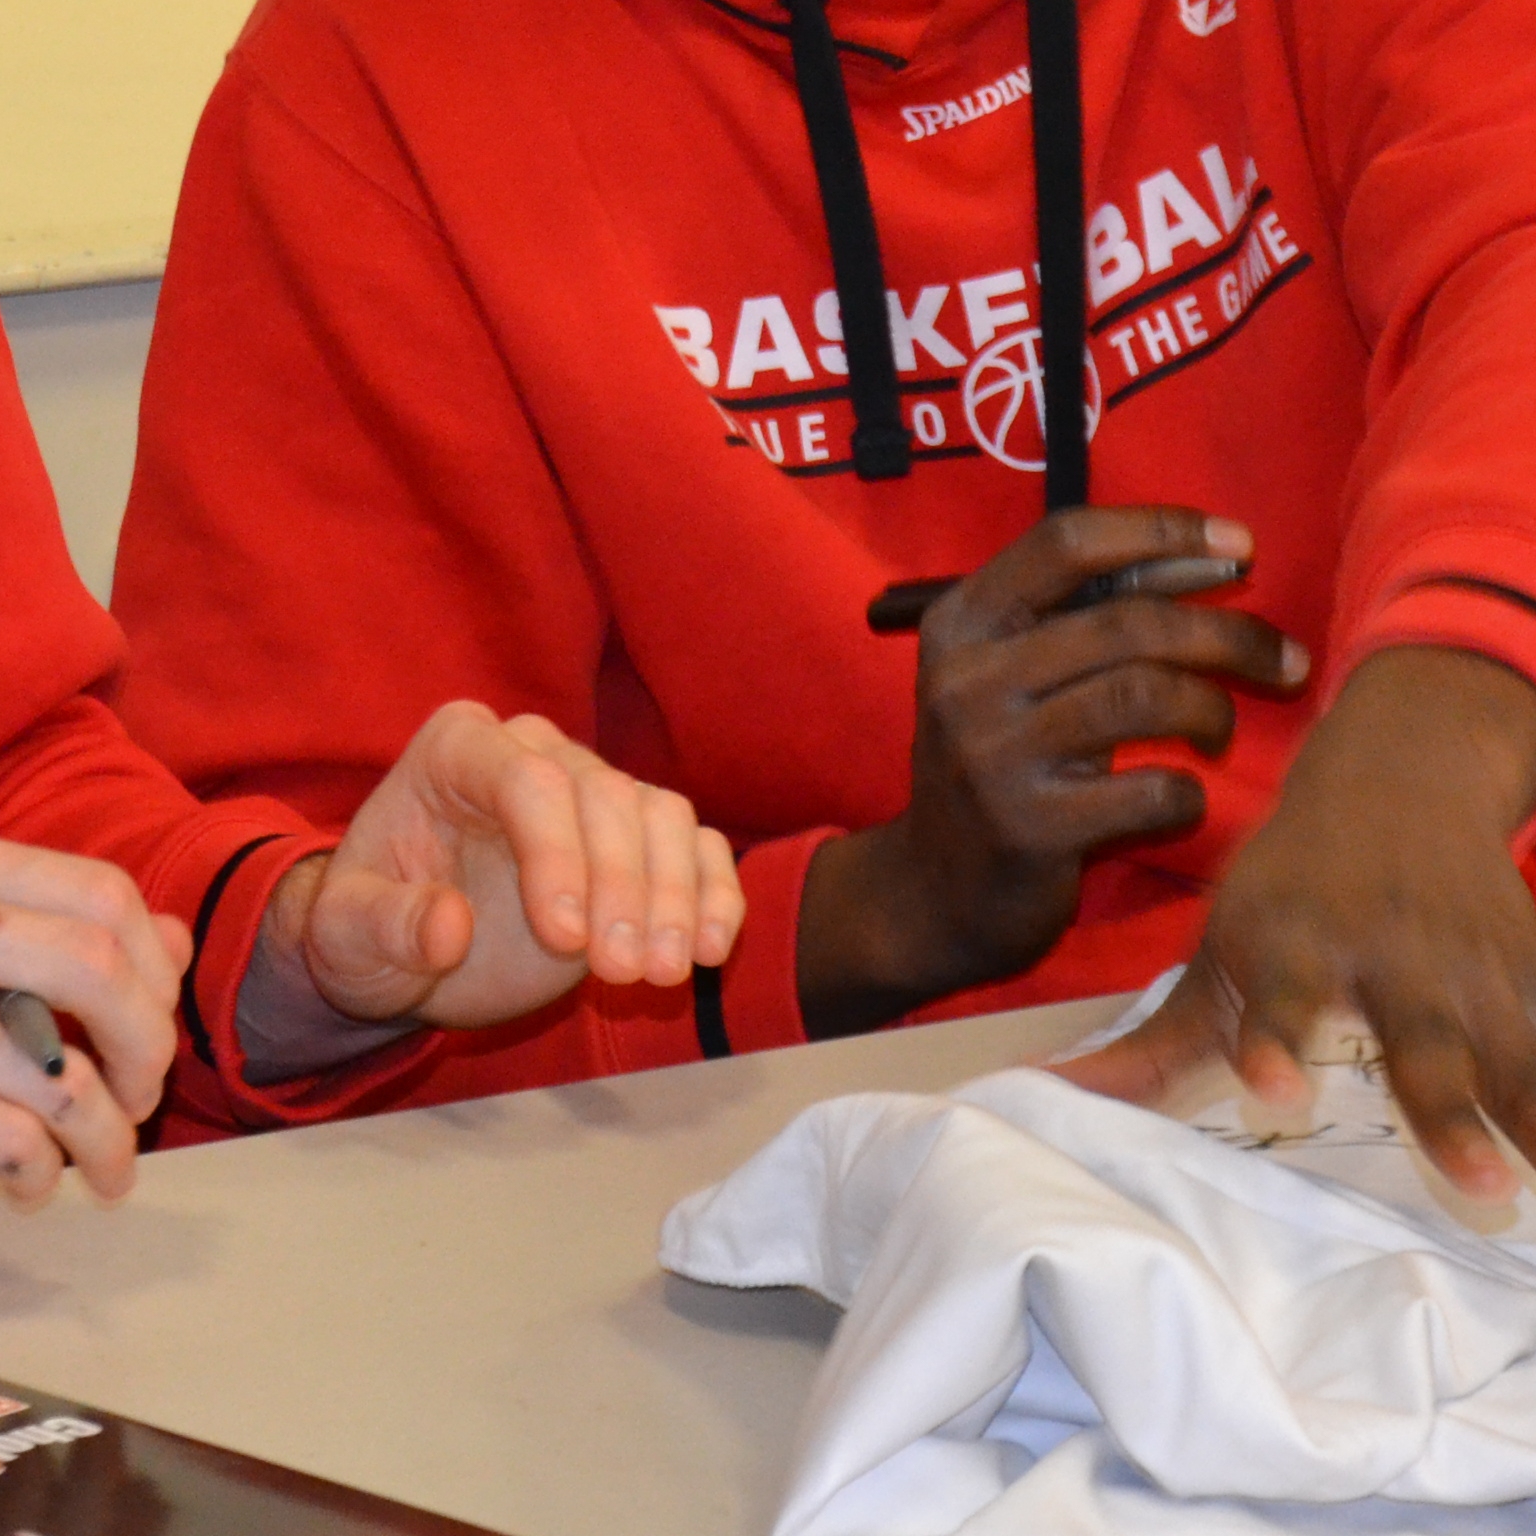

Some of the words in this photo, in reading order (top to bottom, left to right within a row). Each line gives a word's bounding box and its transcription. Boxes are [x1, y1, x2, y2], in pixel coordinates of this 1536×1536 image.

[901, 64, 1032, 142] SPALDIN
[653, 144, 1260, 389] BASKEBAL
[1109, 294, 1209, 378] THE
